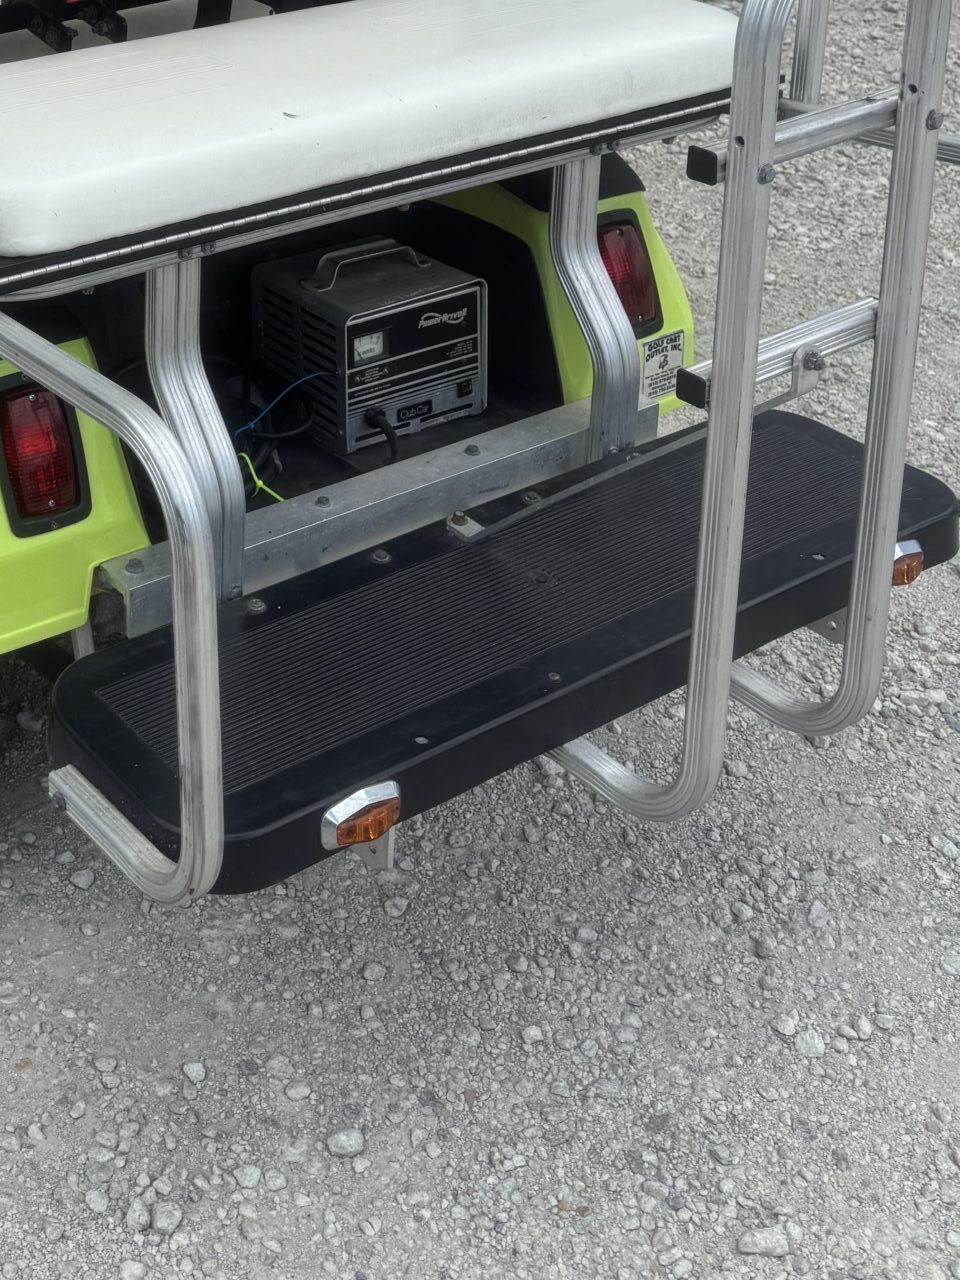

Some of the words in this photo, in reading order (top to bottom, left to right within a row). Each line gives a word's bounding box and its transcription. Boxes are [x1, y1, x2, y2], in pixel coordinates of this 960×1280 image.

[648, 340, 665, 352] GOLF
[666, 335, 680, 345] CART
[401, 407, 416, 419] Club
[417, 403, 429, 415] Car
